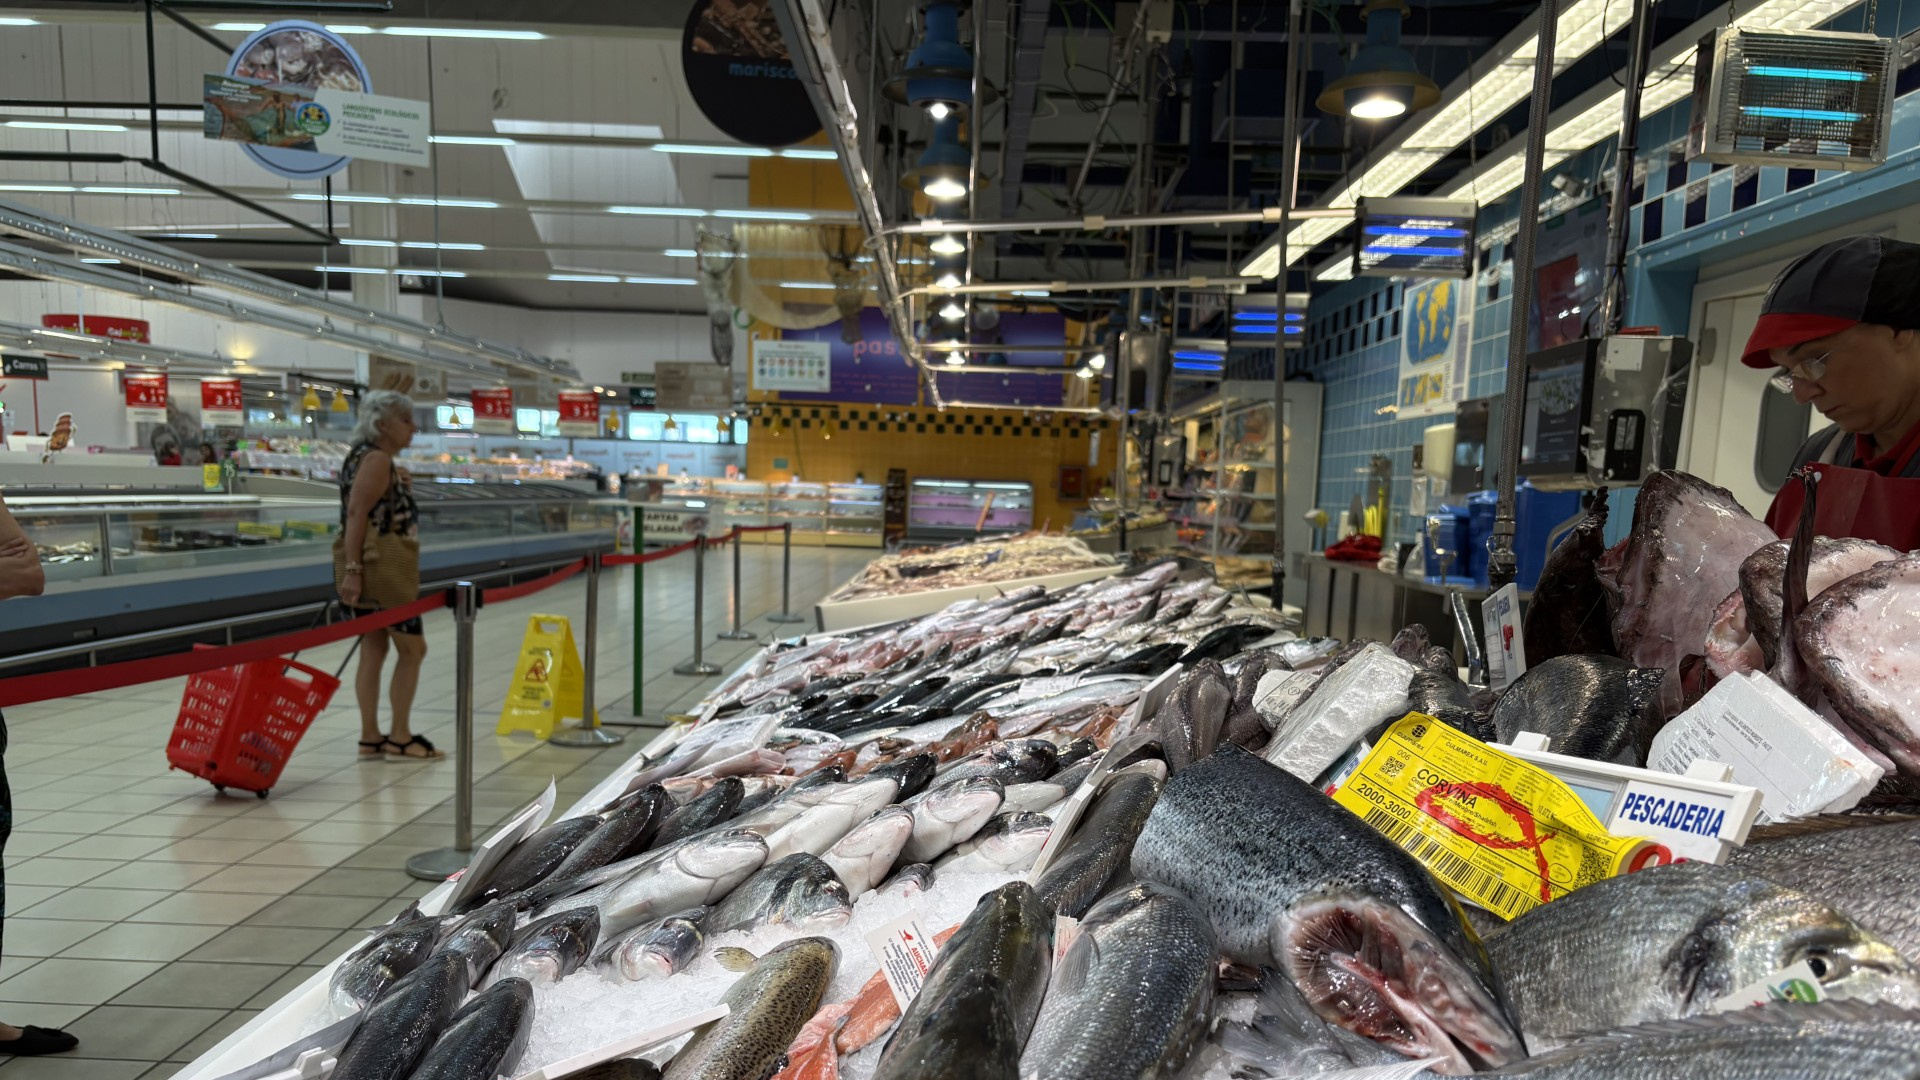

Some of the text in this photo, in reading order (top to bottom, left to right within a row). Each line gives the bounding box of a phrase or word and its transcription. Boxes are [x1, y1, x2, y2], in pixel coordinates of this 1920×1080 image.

[1397, 749, 1410, 760] 006
[1445, 741, 1474, 759] CULMAREX
[1357, 783, 1412, 820] 2000-3000
[1417, 768, 1478, 809] CORVINA
[1619, 792, 1725, 839] PESCADERIA
[890, 942, 900, 959] Santiago
[896, 944, 911, 970] Departamento
[910, 946, 929, 975] AUCHAN
